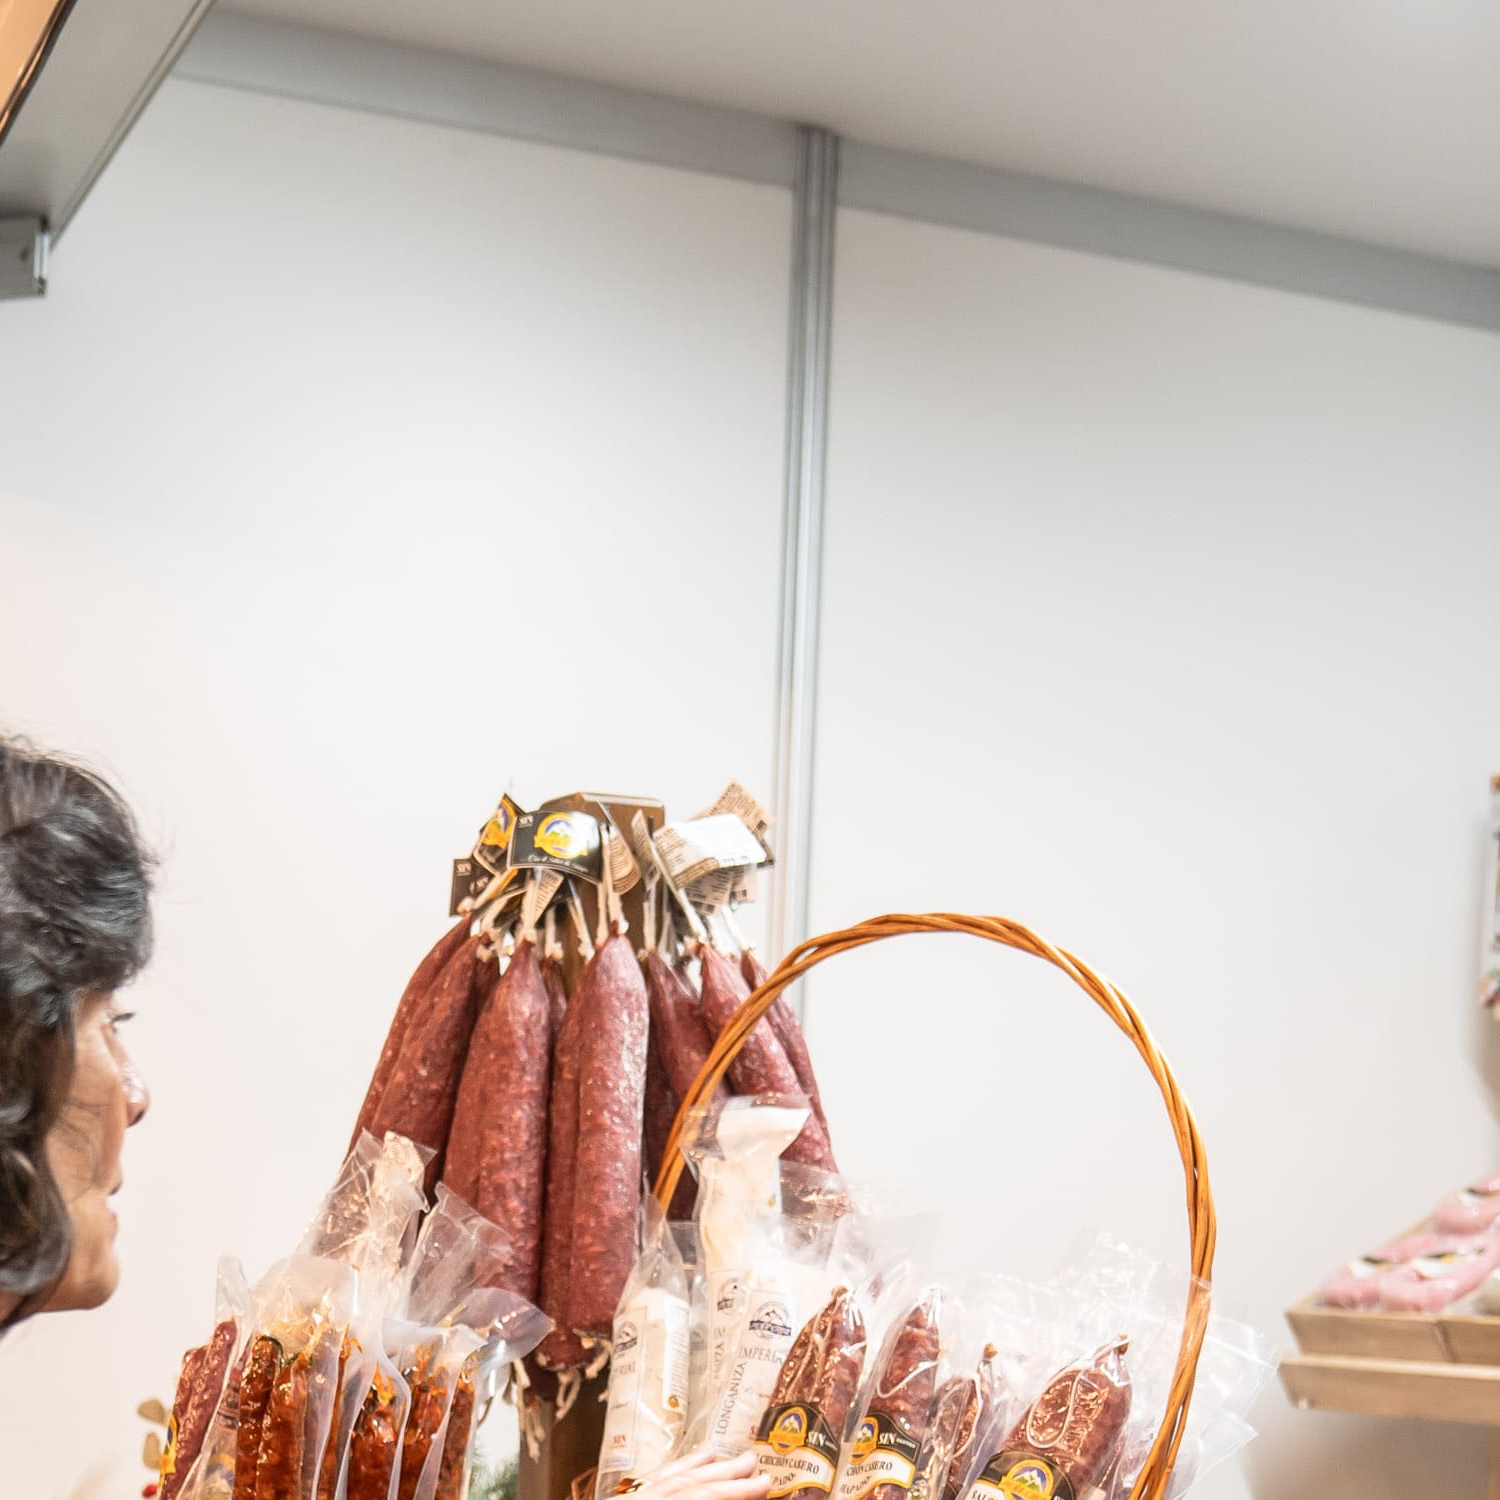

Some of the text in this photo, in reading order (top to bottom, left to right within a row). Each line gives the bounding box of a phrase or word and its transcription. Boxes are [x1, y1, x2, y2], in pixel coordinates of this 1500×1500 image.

[715, 1362, 747, 1435] LONGANIZA
[806, 1431, 827, 1447] SIN
[878, 1432, 896, 1446] SIN
[789, 1458, 820, 1475] CASERO
[864, 1460, 893, 1474] CASERO
